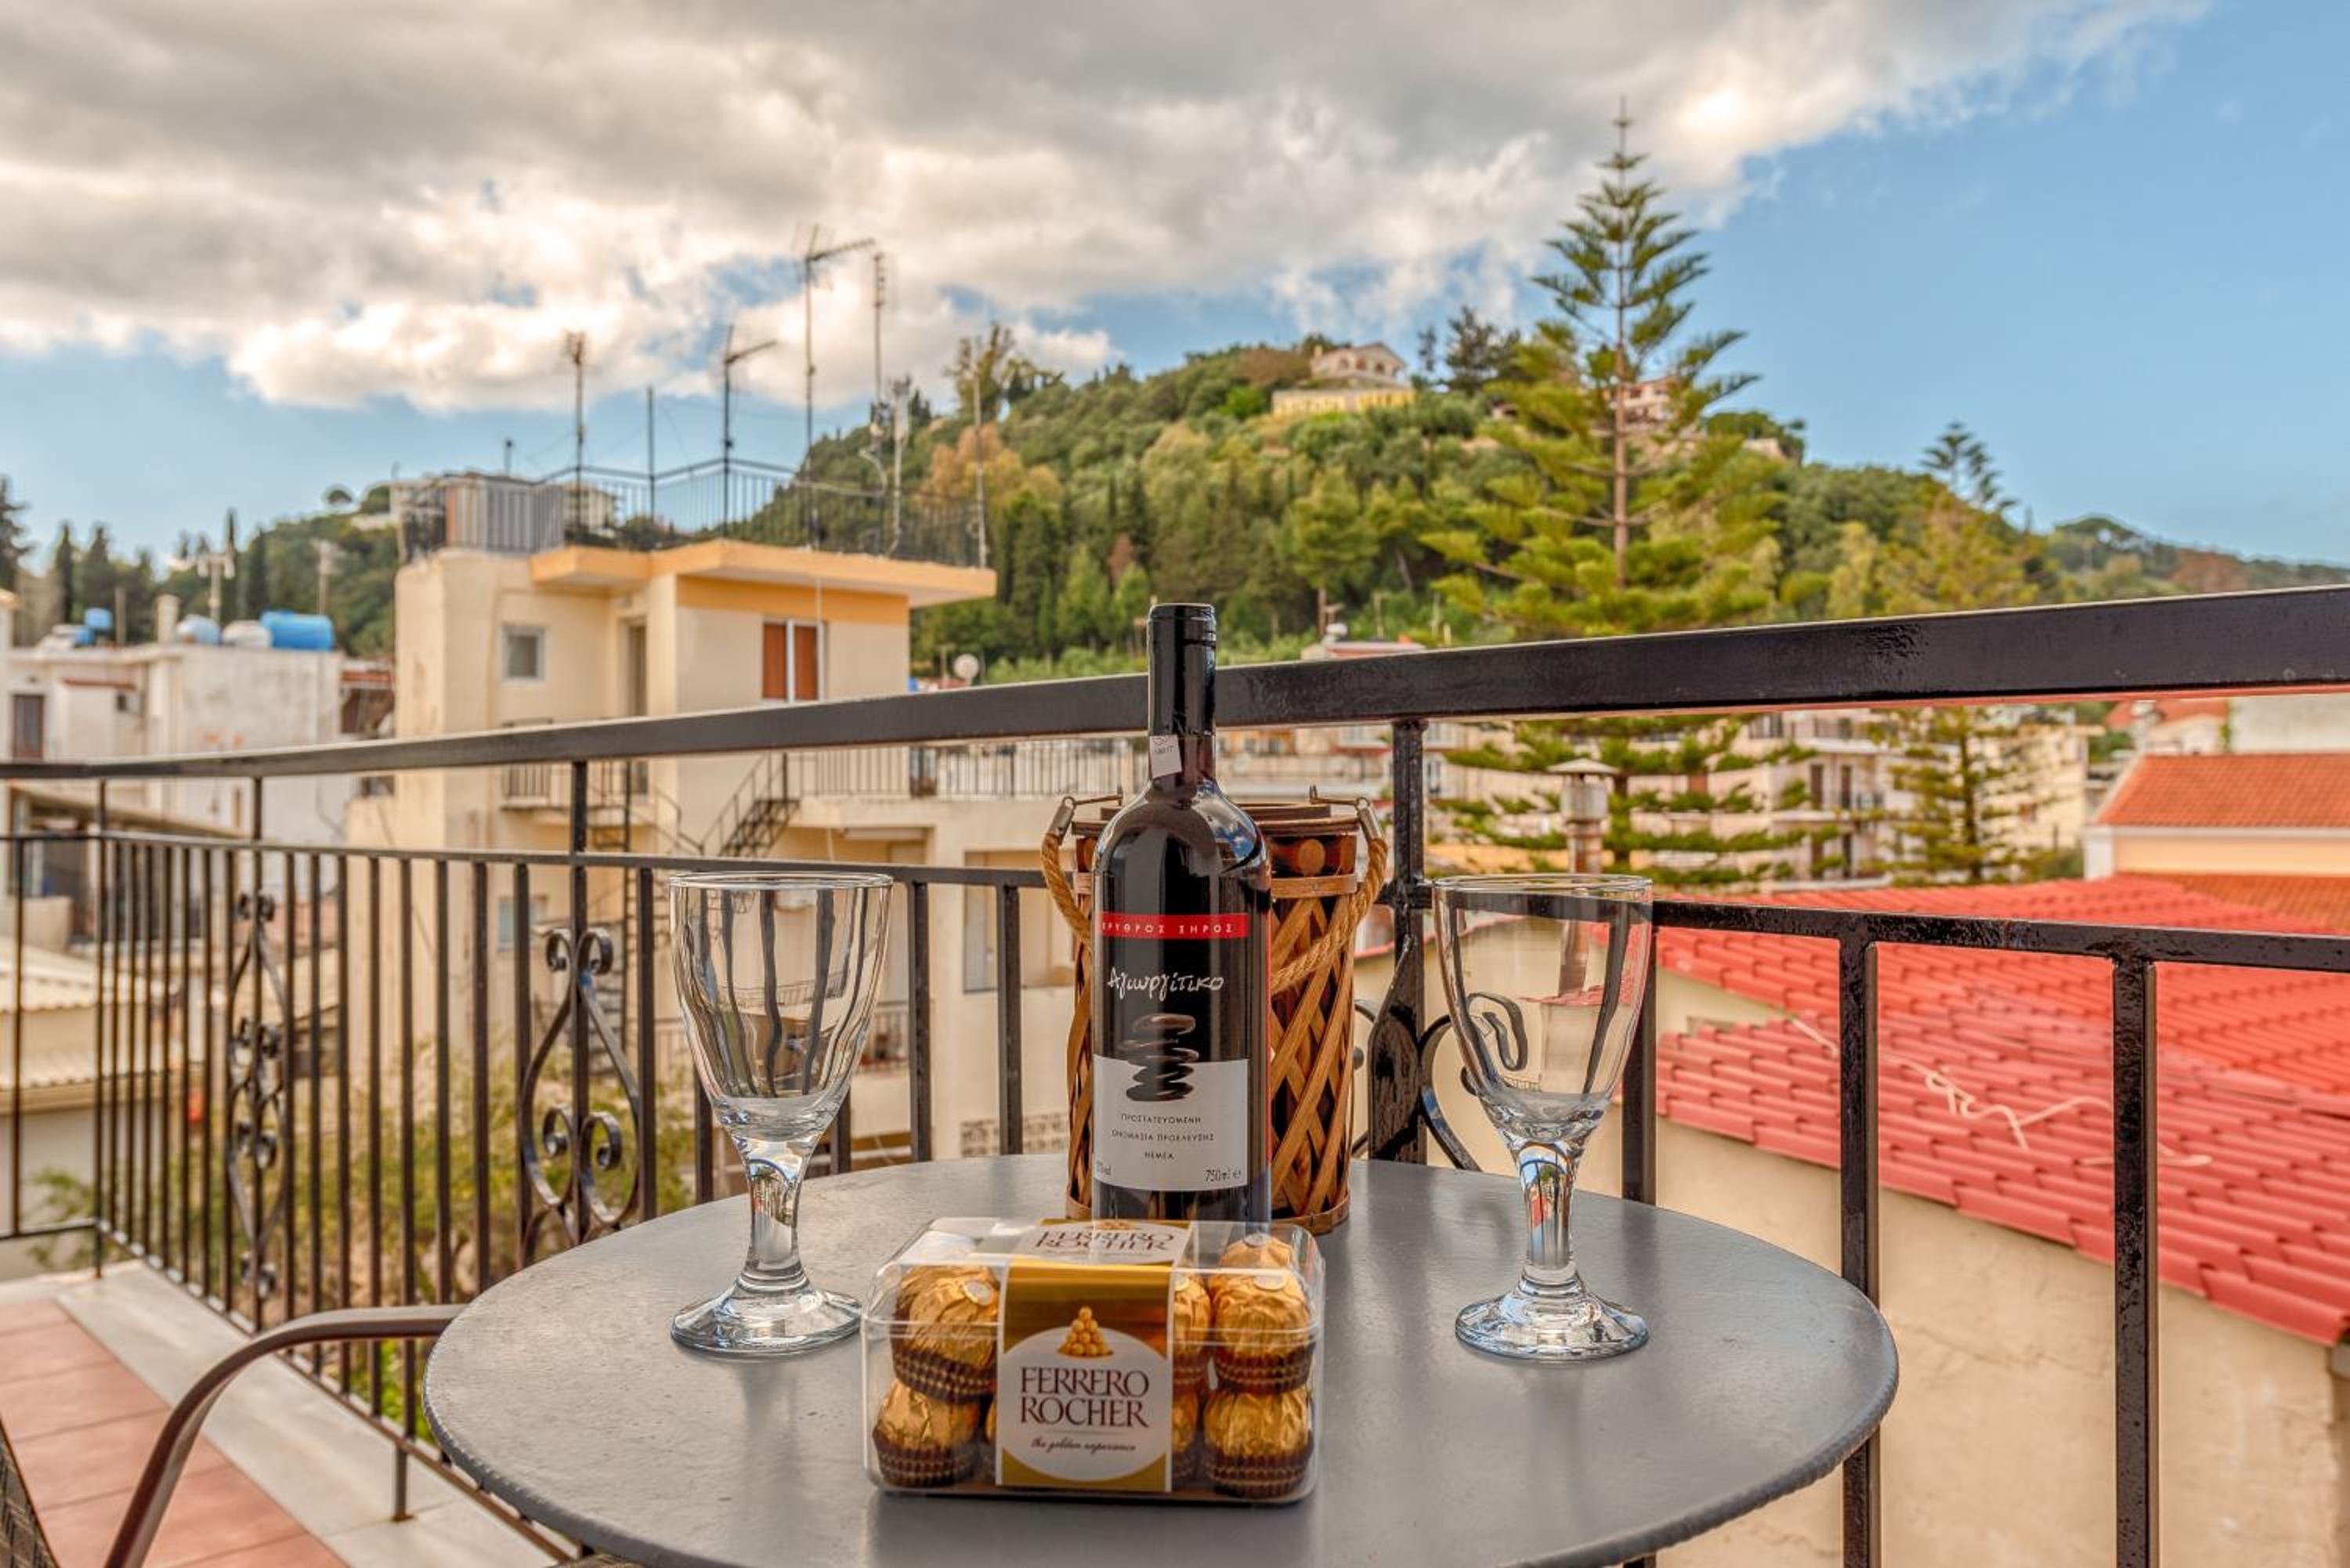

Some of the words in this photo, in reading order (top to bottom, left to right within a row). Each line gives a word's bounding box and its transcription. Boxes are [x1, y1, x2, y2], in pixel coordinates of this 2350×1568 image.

[1021, 1367, 1150, 1397] FERRERO
[1021, 1396, 1149, 1428] ROCHER
[1031, 1436, 1046, 1448] the
[1046, 1436, 1081, 1454] golden
[1083, 1443, 1137, 1455] experience
